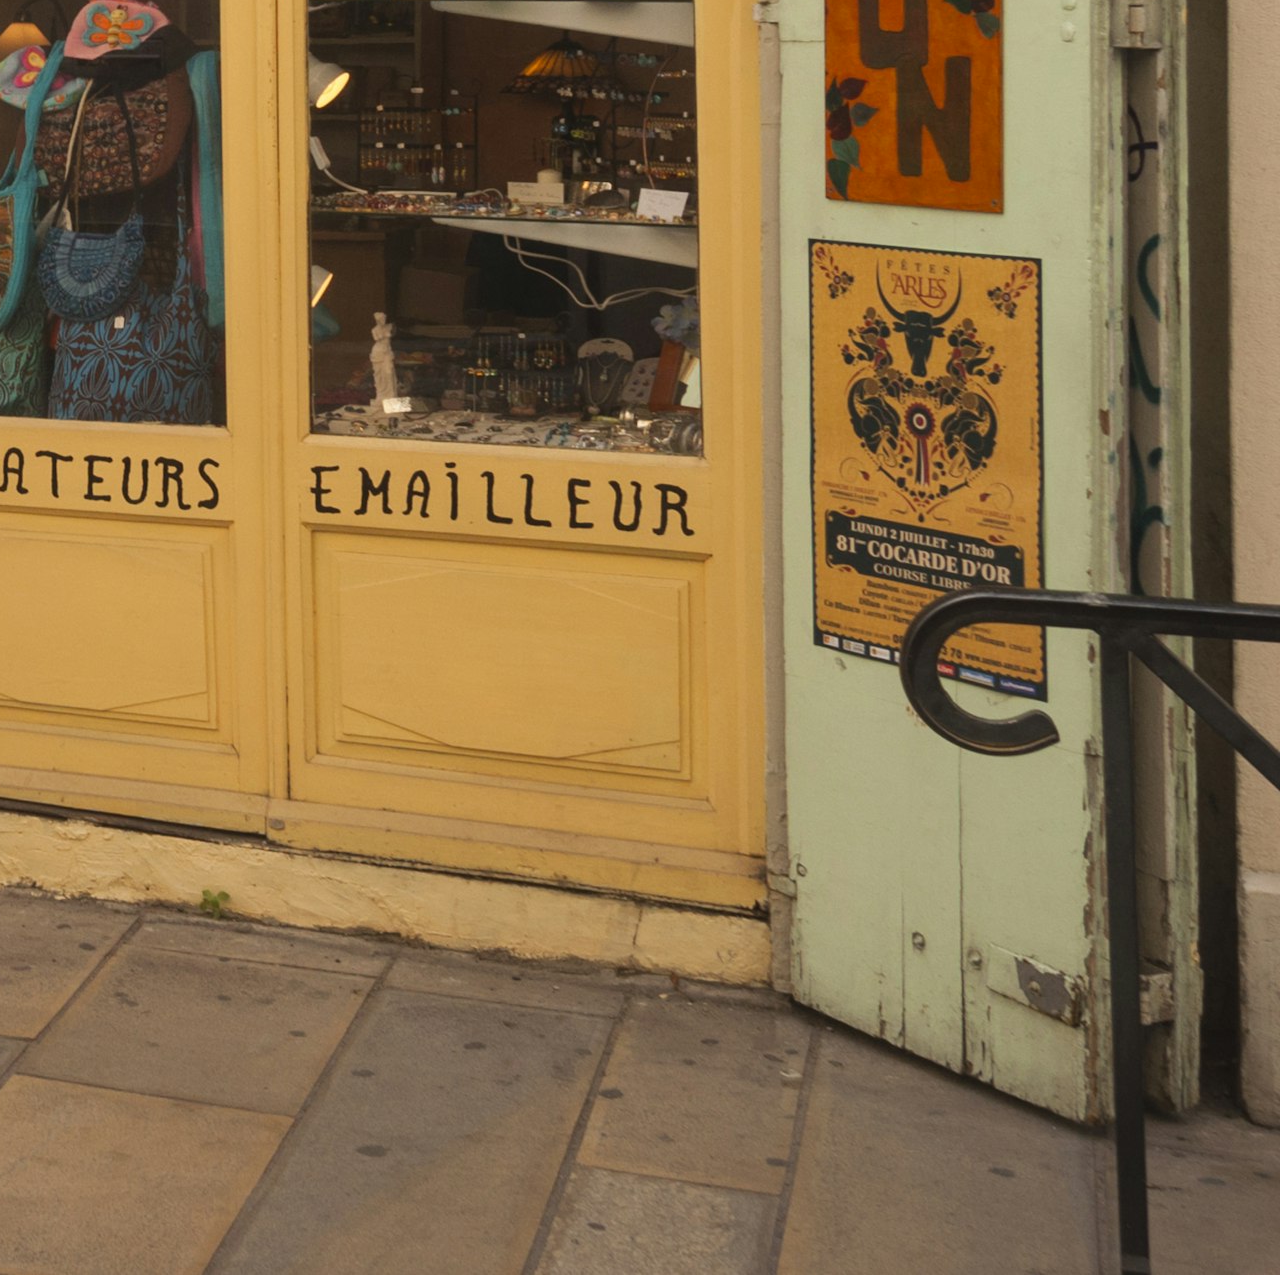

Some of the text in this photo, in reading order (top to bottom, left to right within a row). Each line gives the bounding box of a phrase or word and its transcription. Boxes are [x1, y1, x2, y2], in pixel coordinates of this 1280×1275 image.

[886, 258, 951, 275] FÊTES
[850, 520, 889, 539] LUNDI
[890, 529, 898, 540] 2
[899, 530, 949, 551] JUILLET
[957, 541, 996, 560] 17h30
[866, 539, 959, 574] COCARDE
[961, 558, 1012, 586] D'OR
[873, 562, 929, 584] COURSE
